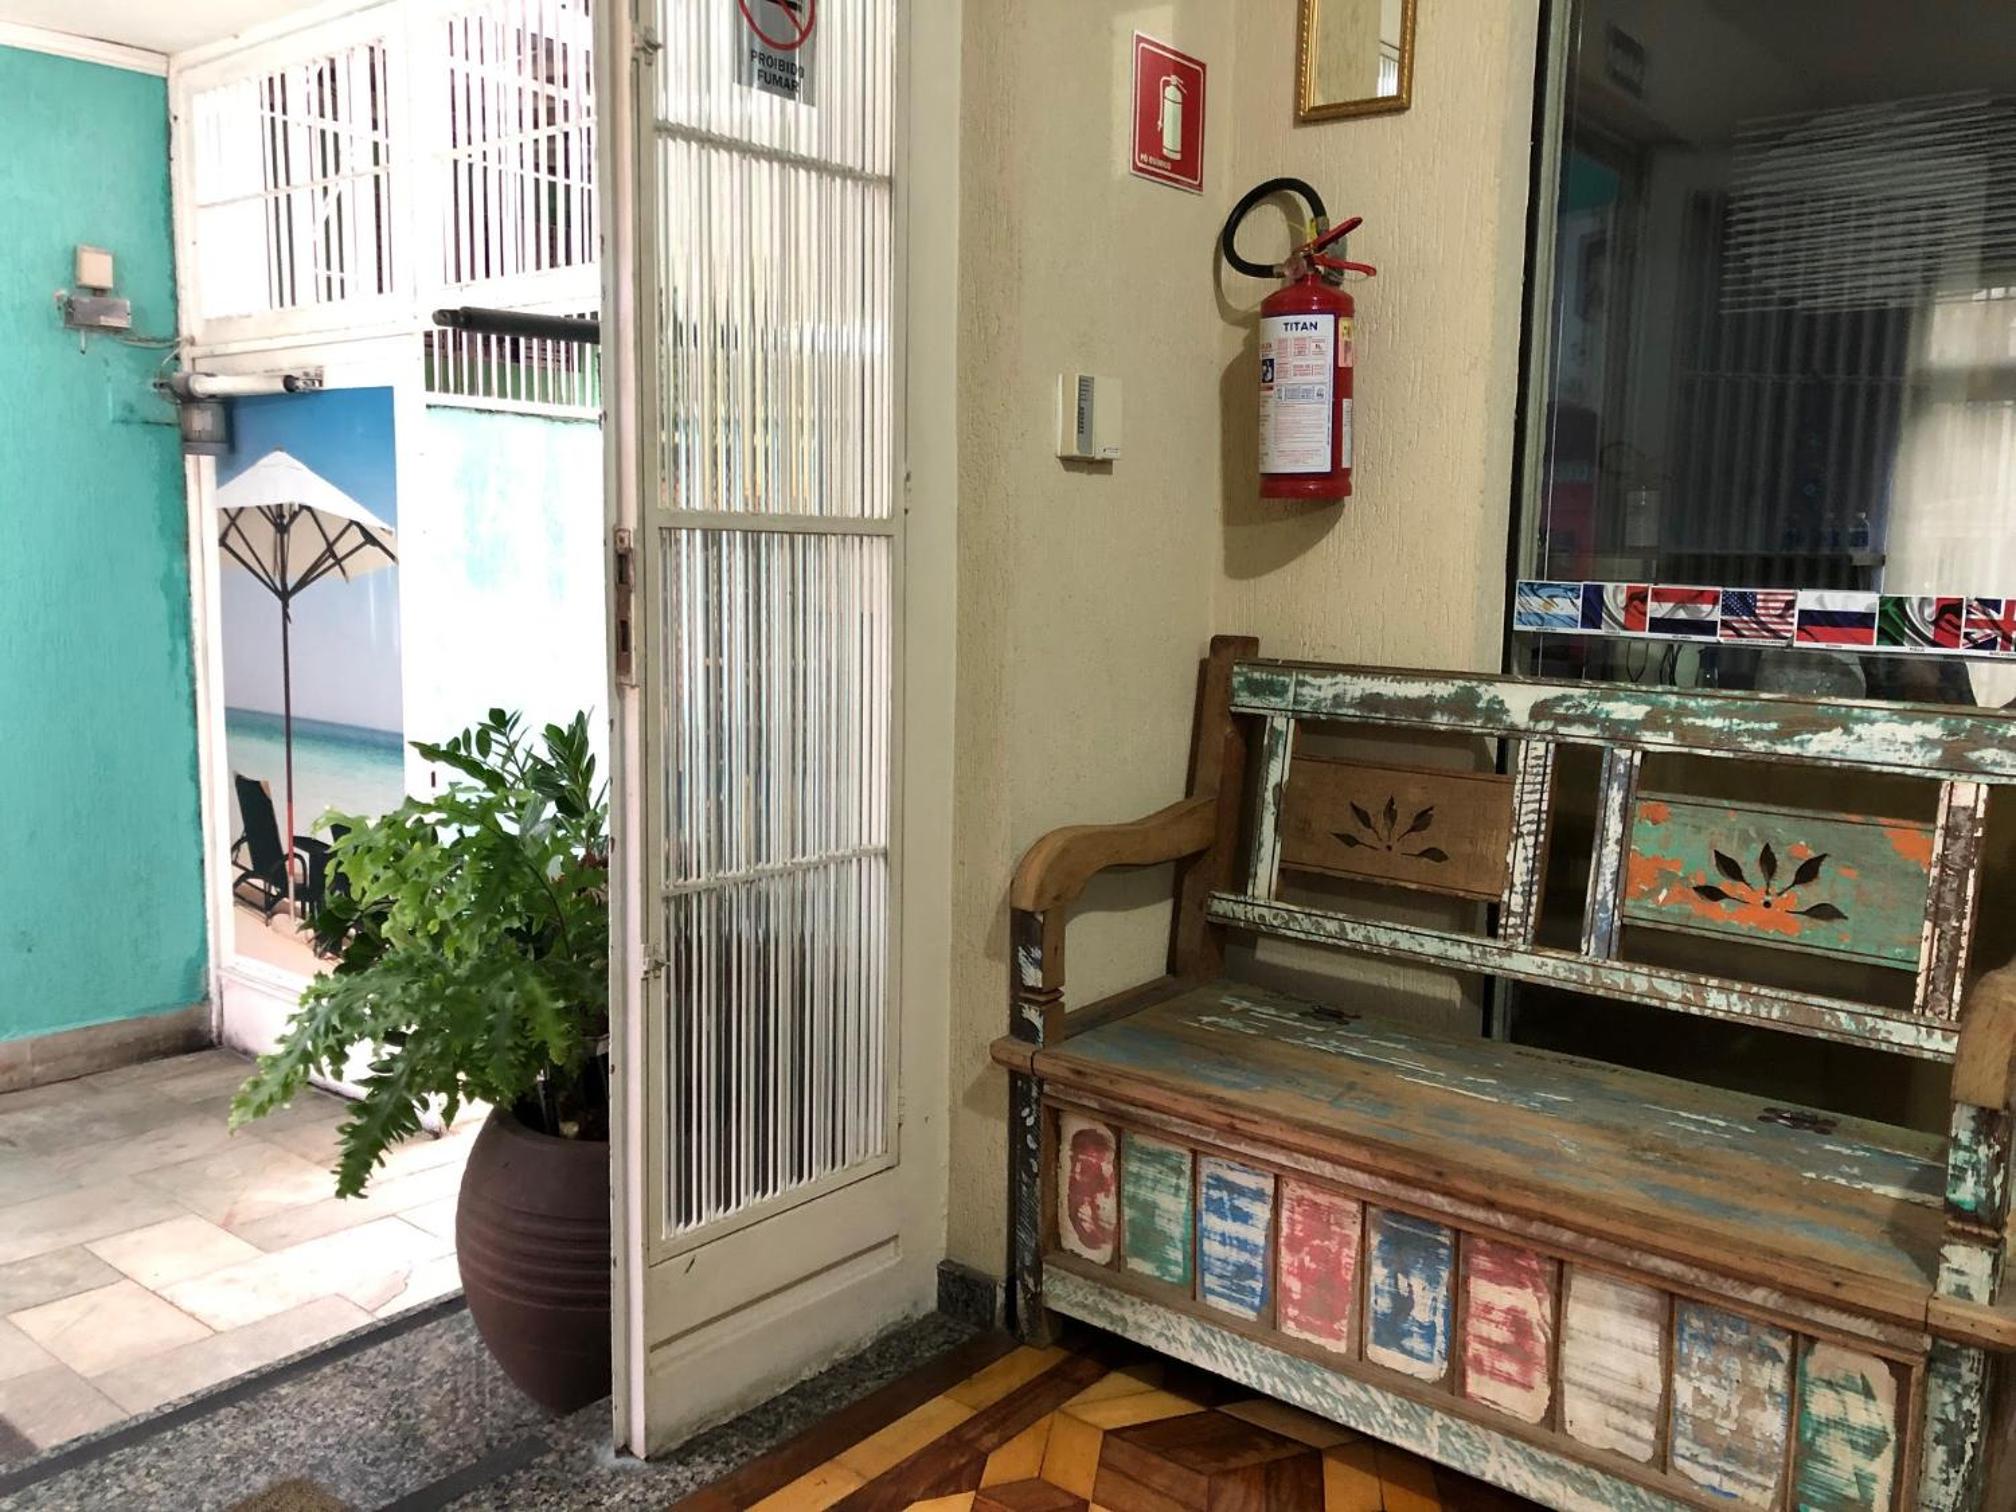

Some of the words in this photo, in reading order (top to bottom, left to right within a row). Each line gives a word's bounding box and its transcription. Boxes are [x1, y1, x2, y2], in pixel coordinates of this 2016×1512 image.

[751, 49, 805, 79] PROIBIDO
[757, 69, 799, 93] FUMAR
[1283, 321, 1318, 332] TITAN
